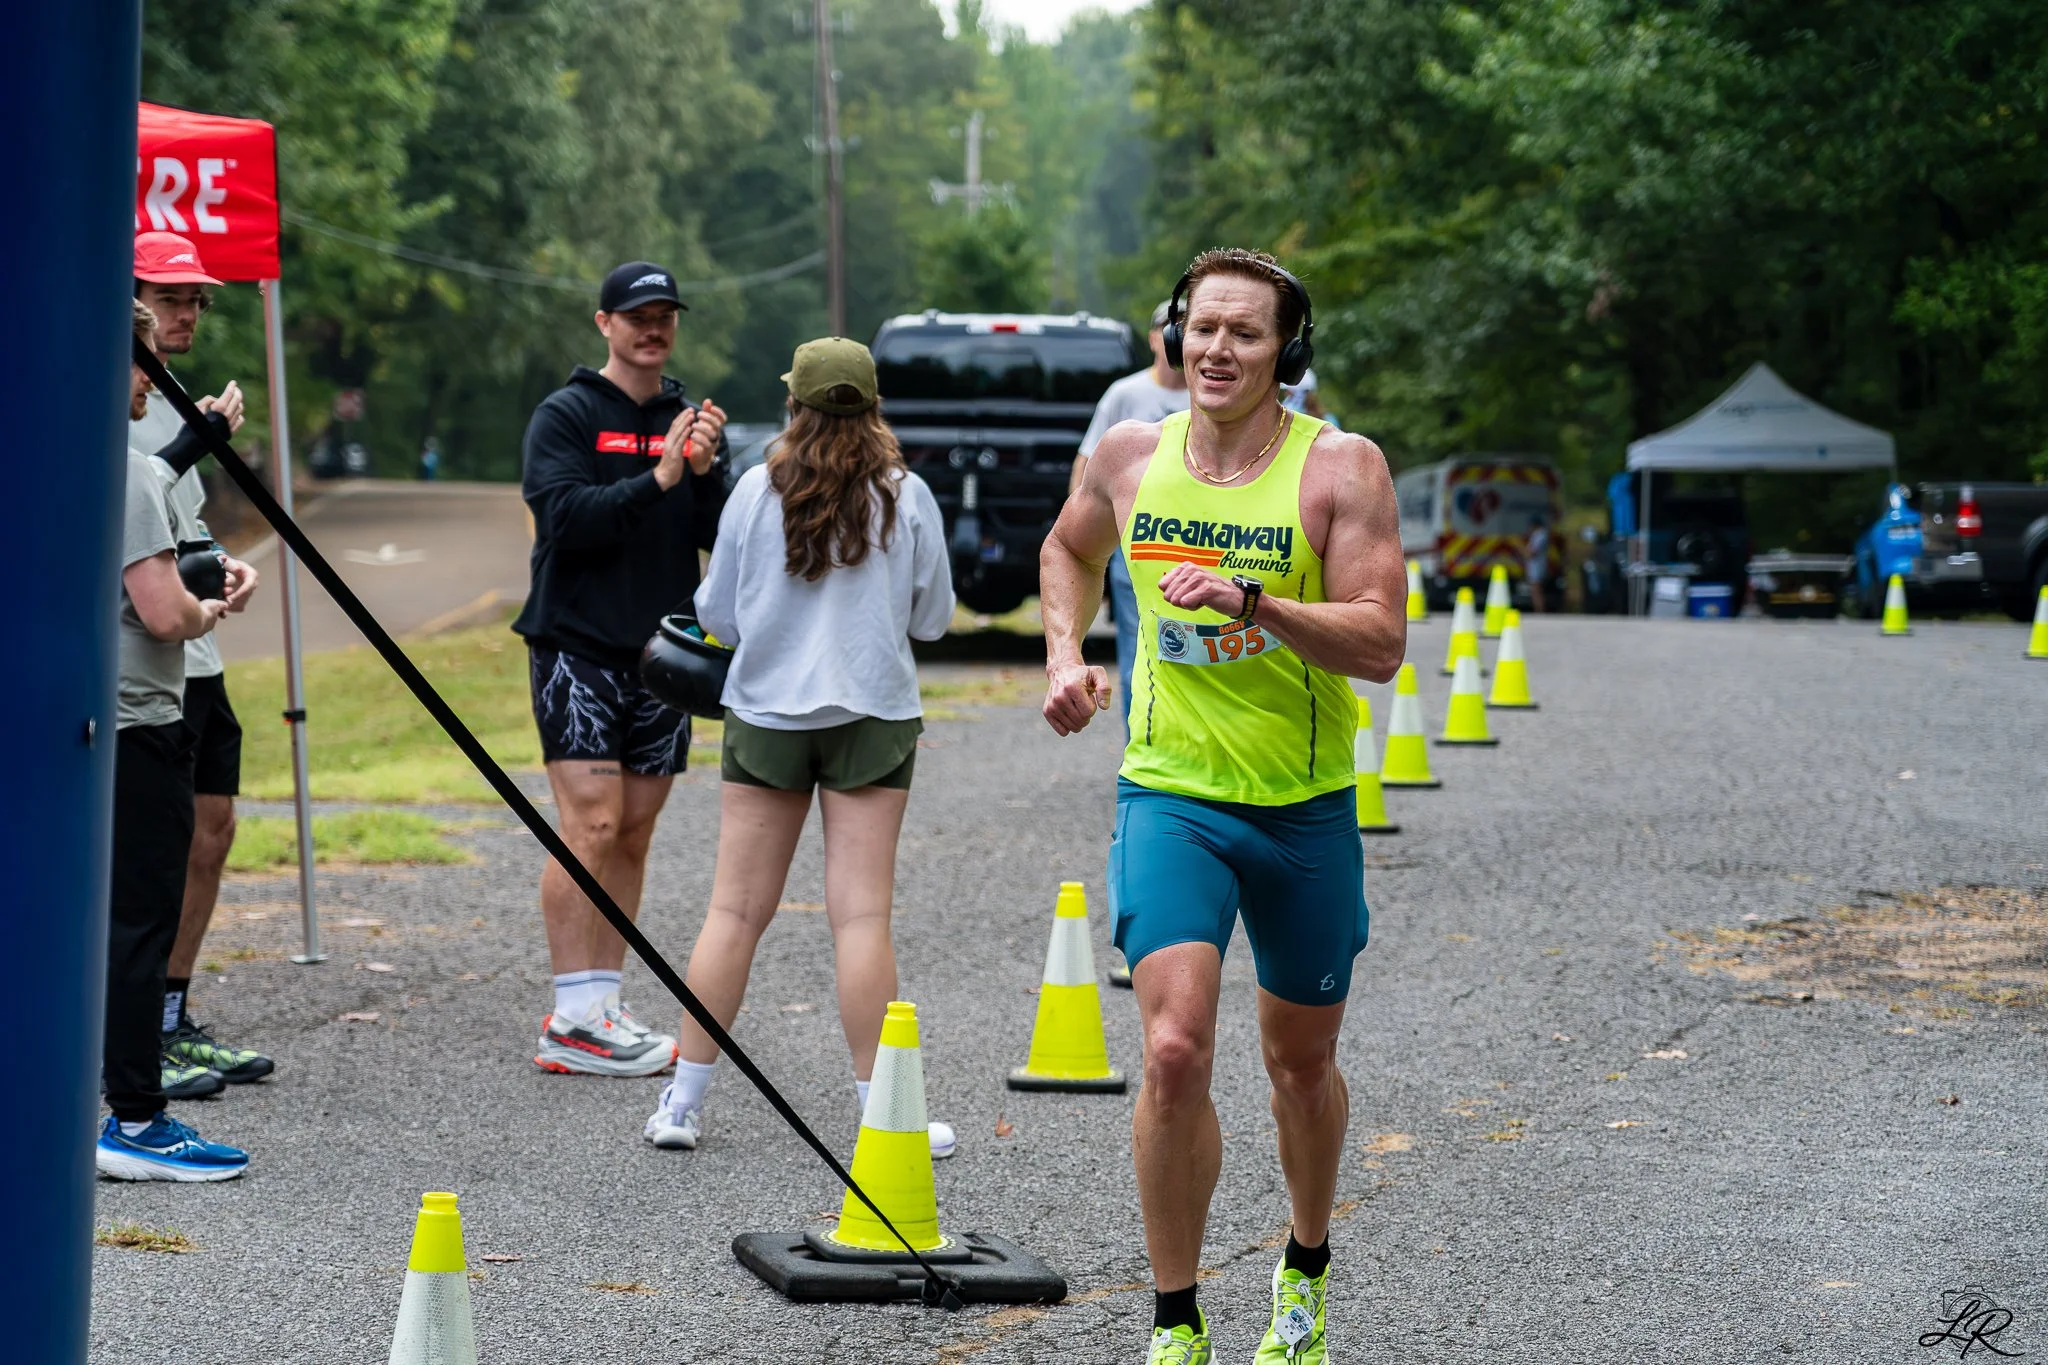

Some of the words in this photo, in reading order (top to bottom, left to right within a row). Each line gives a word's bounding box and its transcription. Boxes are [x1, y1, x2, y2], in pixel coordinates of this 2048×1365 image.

[1132, 513, 1293, 559] Breakaway
[1220, 552, 1293, 577] Running
[1203, 627, 1265, 663] 195
